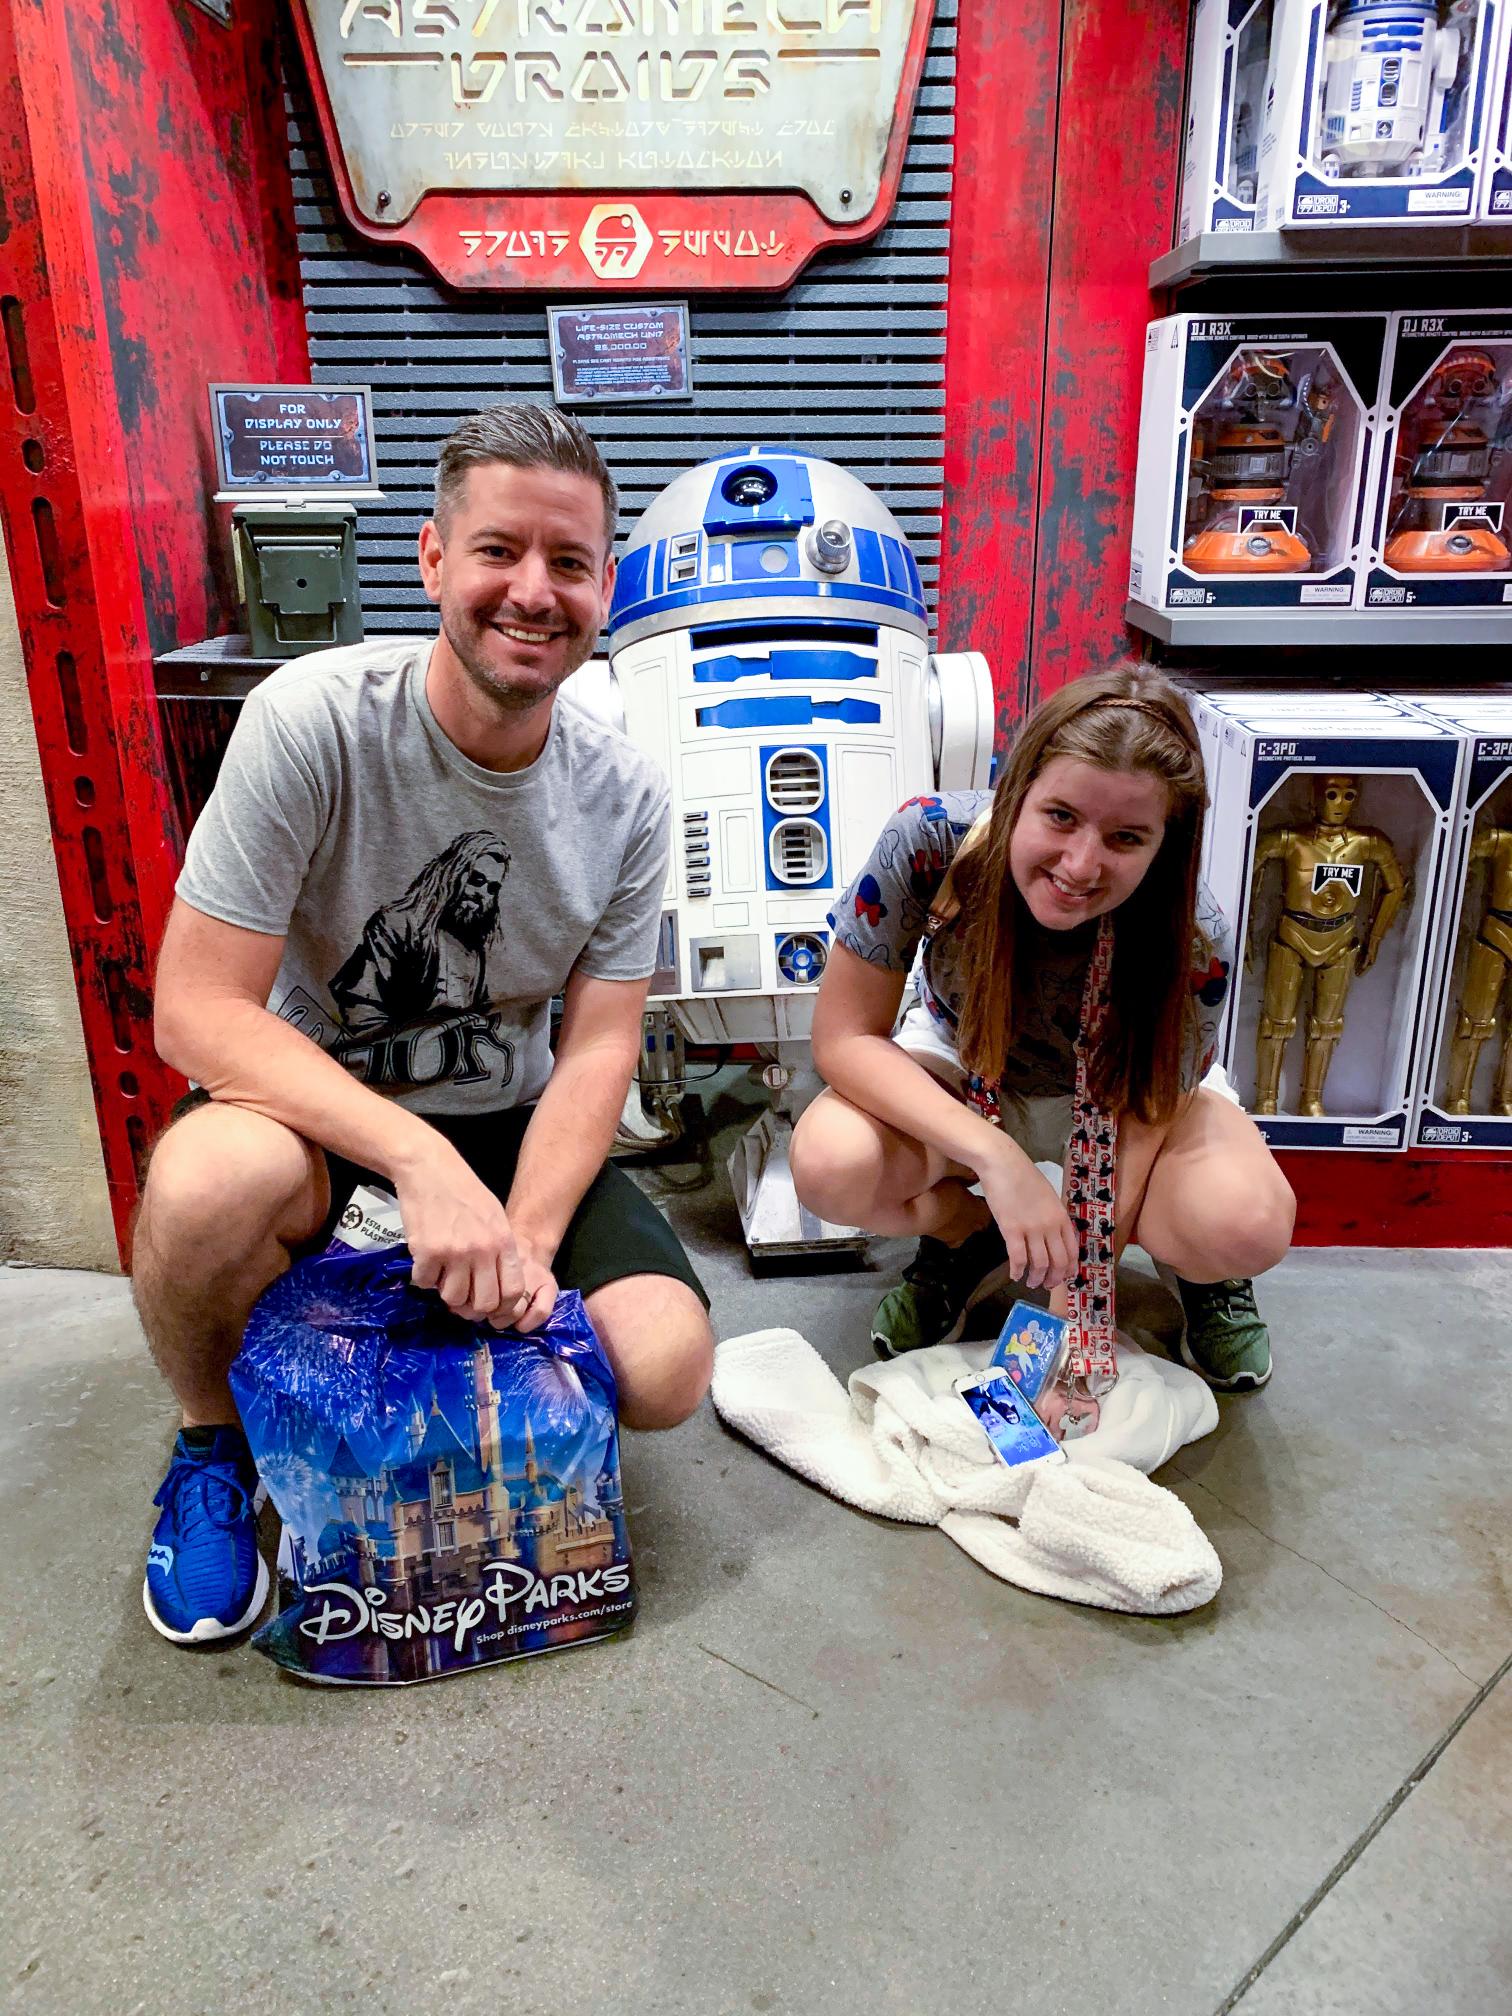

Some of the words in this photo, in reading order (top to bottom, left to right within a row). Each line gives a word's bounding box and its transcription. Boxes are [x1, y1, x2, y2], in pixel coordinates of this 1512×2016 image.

[450, 50, 771, 103] DROIDS
[575, 323, 621, 332] LIFE-SIZE
[623, 322, 664, 330] CUSTOM
[1191, 322, 1206, 336] DJ
[1209, 321, 1232, 335] R3X
[1402, 318, 1418, 332] DJ
[1421, 318, 1445, 332] R3X
[576, 332, 639, 341] ASTROMECH
[640, 330, 664, 339] UNIT
[279, 404, 306, 414] FOR
[244, 418, 302, 429] DISPLAY
[306, 418, 342, 429] ONLY
[260, 440, 310, 451] PLEASE
[313, 440, 333, 451] DO
[260, 455, 286, 465] NOT
[289, 455, 335, 465] TOUCH
[1254, 510, 1269, 519] TRY
[1270, 510, 1281, 519] ME
[1458, 506, 1474, 516] TRY
[1475, 506, 1487, 515] ME
[1259, 742, 1296, 755] C-3PO
[1323, 867, 1340, 877] TRY
[1341, 868, 1354, 878] ME
[365, 1217, 381, 1231] ESTA
[476, 1630, 504, 1645] Shop
[507, 1601, 633, 1636] disneyparks.com/store
